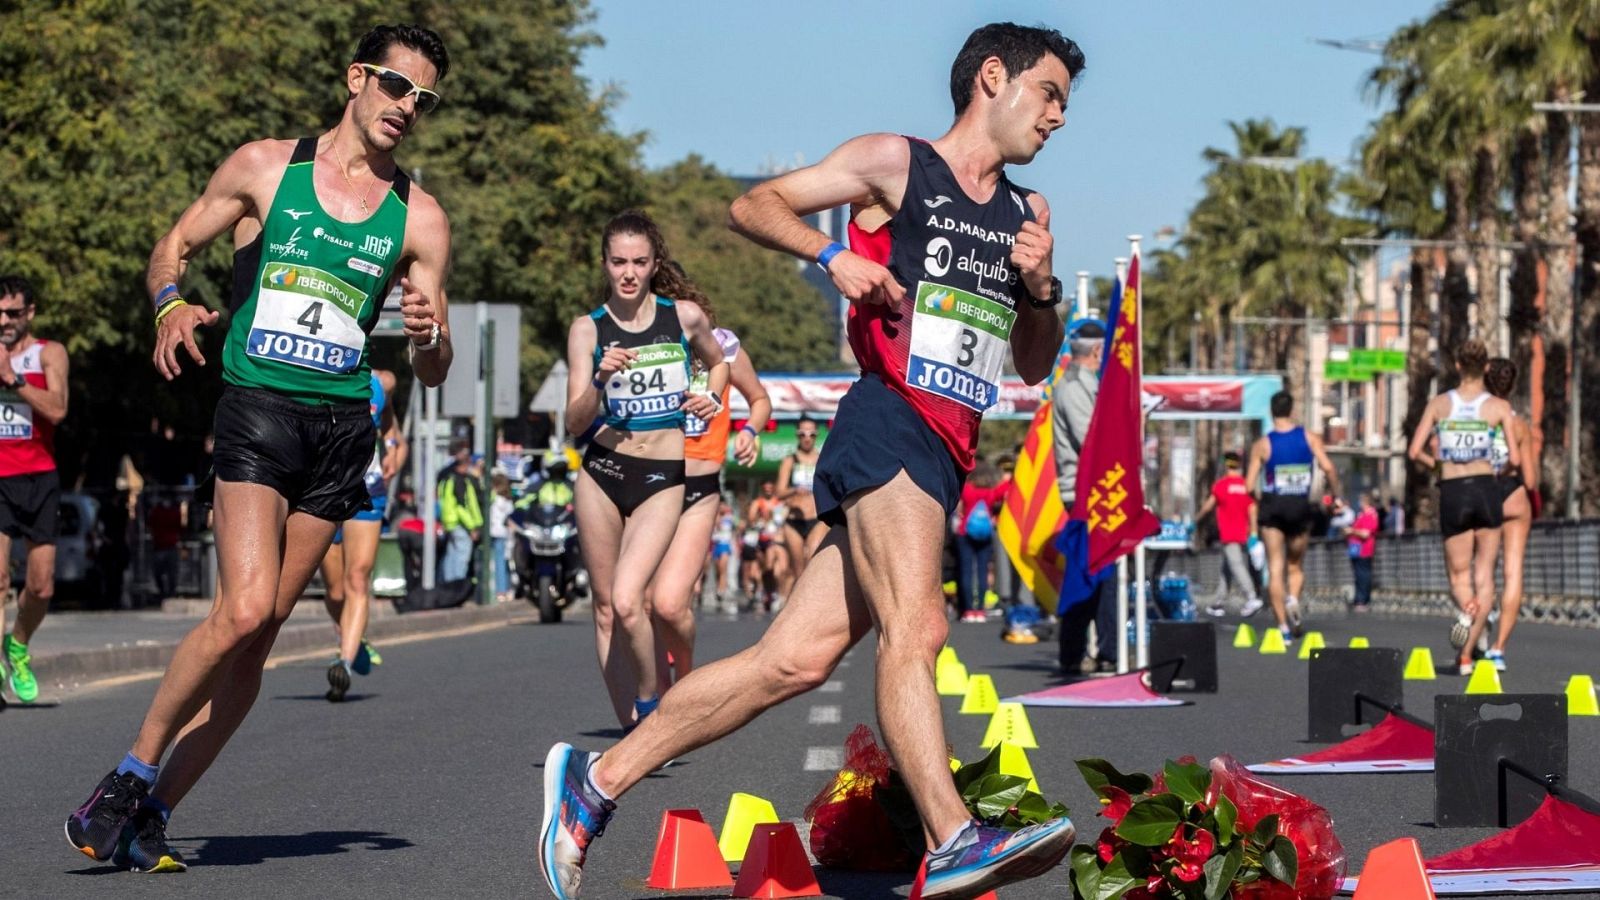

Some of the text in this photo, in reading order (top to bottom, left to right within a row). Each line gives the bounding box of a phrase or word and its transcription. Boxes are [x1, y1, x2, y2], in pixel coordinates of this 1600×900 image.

[323, 234, 354, 249] FISALDE
[927, 214, 1016, 246] A.D.MARATH
[957, 248, 1017, 286] alquibe
[297, 276, 355, 310] IBERDROLA
[297, 301, 324, 335] 4
[956, 301, 1008, 330] IBERDROLA
[630, 350, 681, 363] ERDROLA
[957, 328, 978, 368] 3
[629, 367, 667, 395] 84
[3, 405, 14, 422] 0
[0, 425, 24, 436] ma
[1454, 432, 1475, 448] 70
